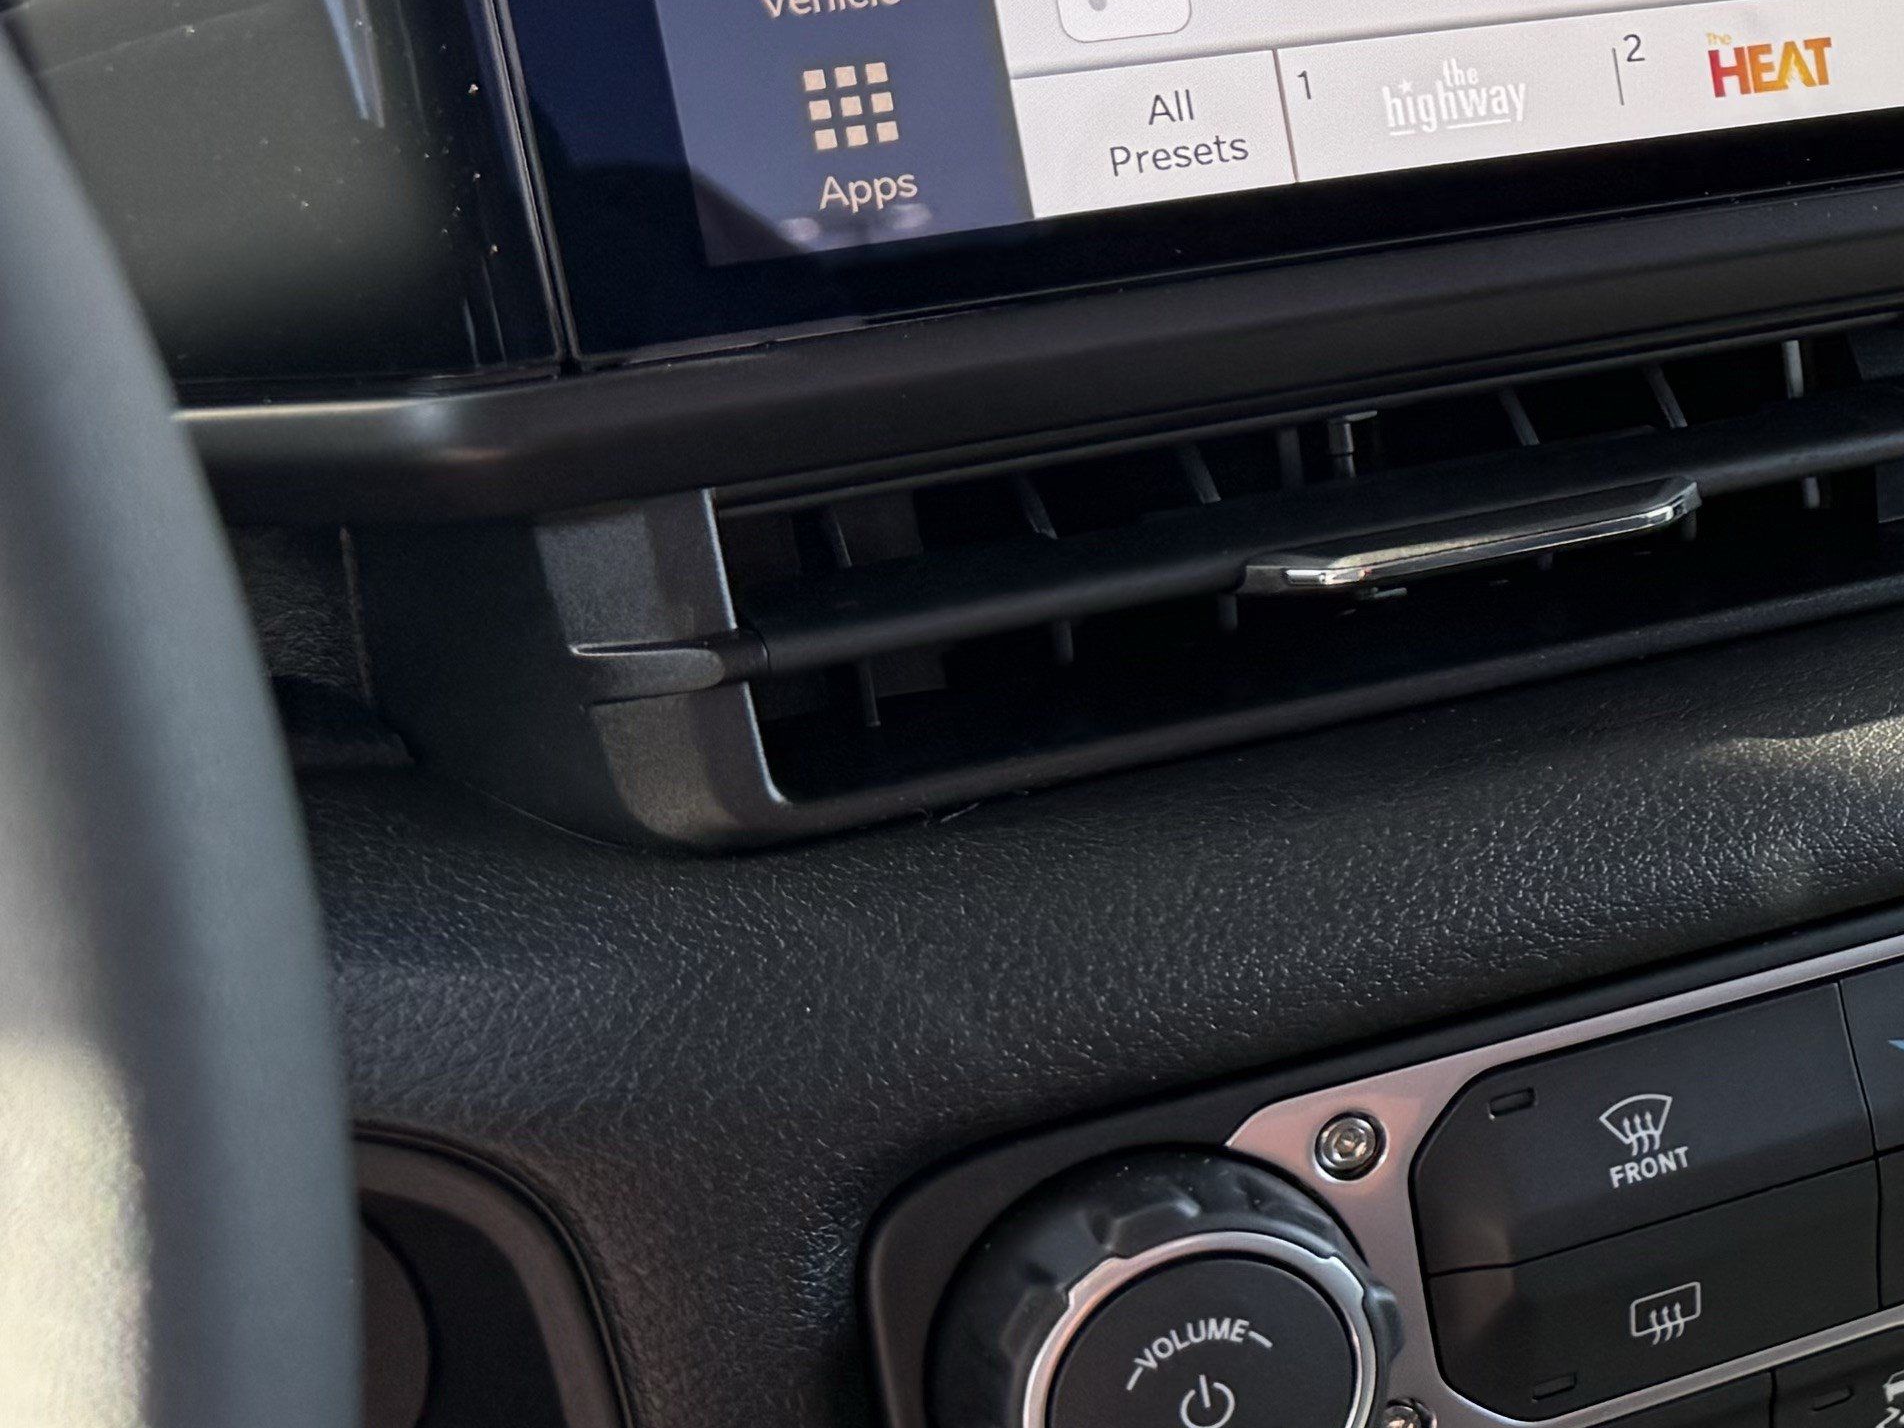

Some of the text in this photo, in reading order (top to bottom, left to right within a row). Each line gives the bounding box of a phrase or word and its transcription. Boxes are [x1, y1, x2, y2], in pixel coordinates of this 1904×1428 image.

[1623, 34, 1645, 63] 2
[1707, 37, 1832, 98] HEAT
[1297, 70, 1313, 100] 1
[1443, 58, 1479, 88] the
[1148, 88, 1195, 125] All
[1382, 79, 1527, 134] highway
[1109, 132, 1249, 177] Presets
[818, 173, 919, 214] Apps
[1609, 1145, 1691, 1188] FRONT
[1134, 1317, 1250, 1372] VOLUME
